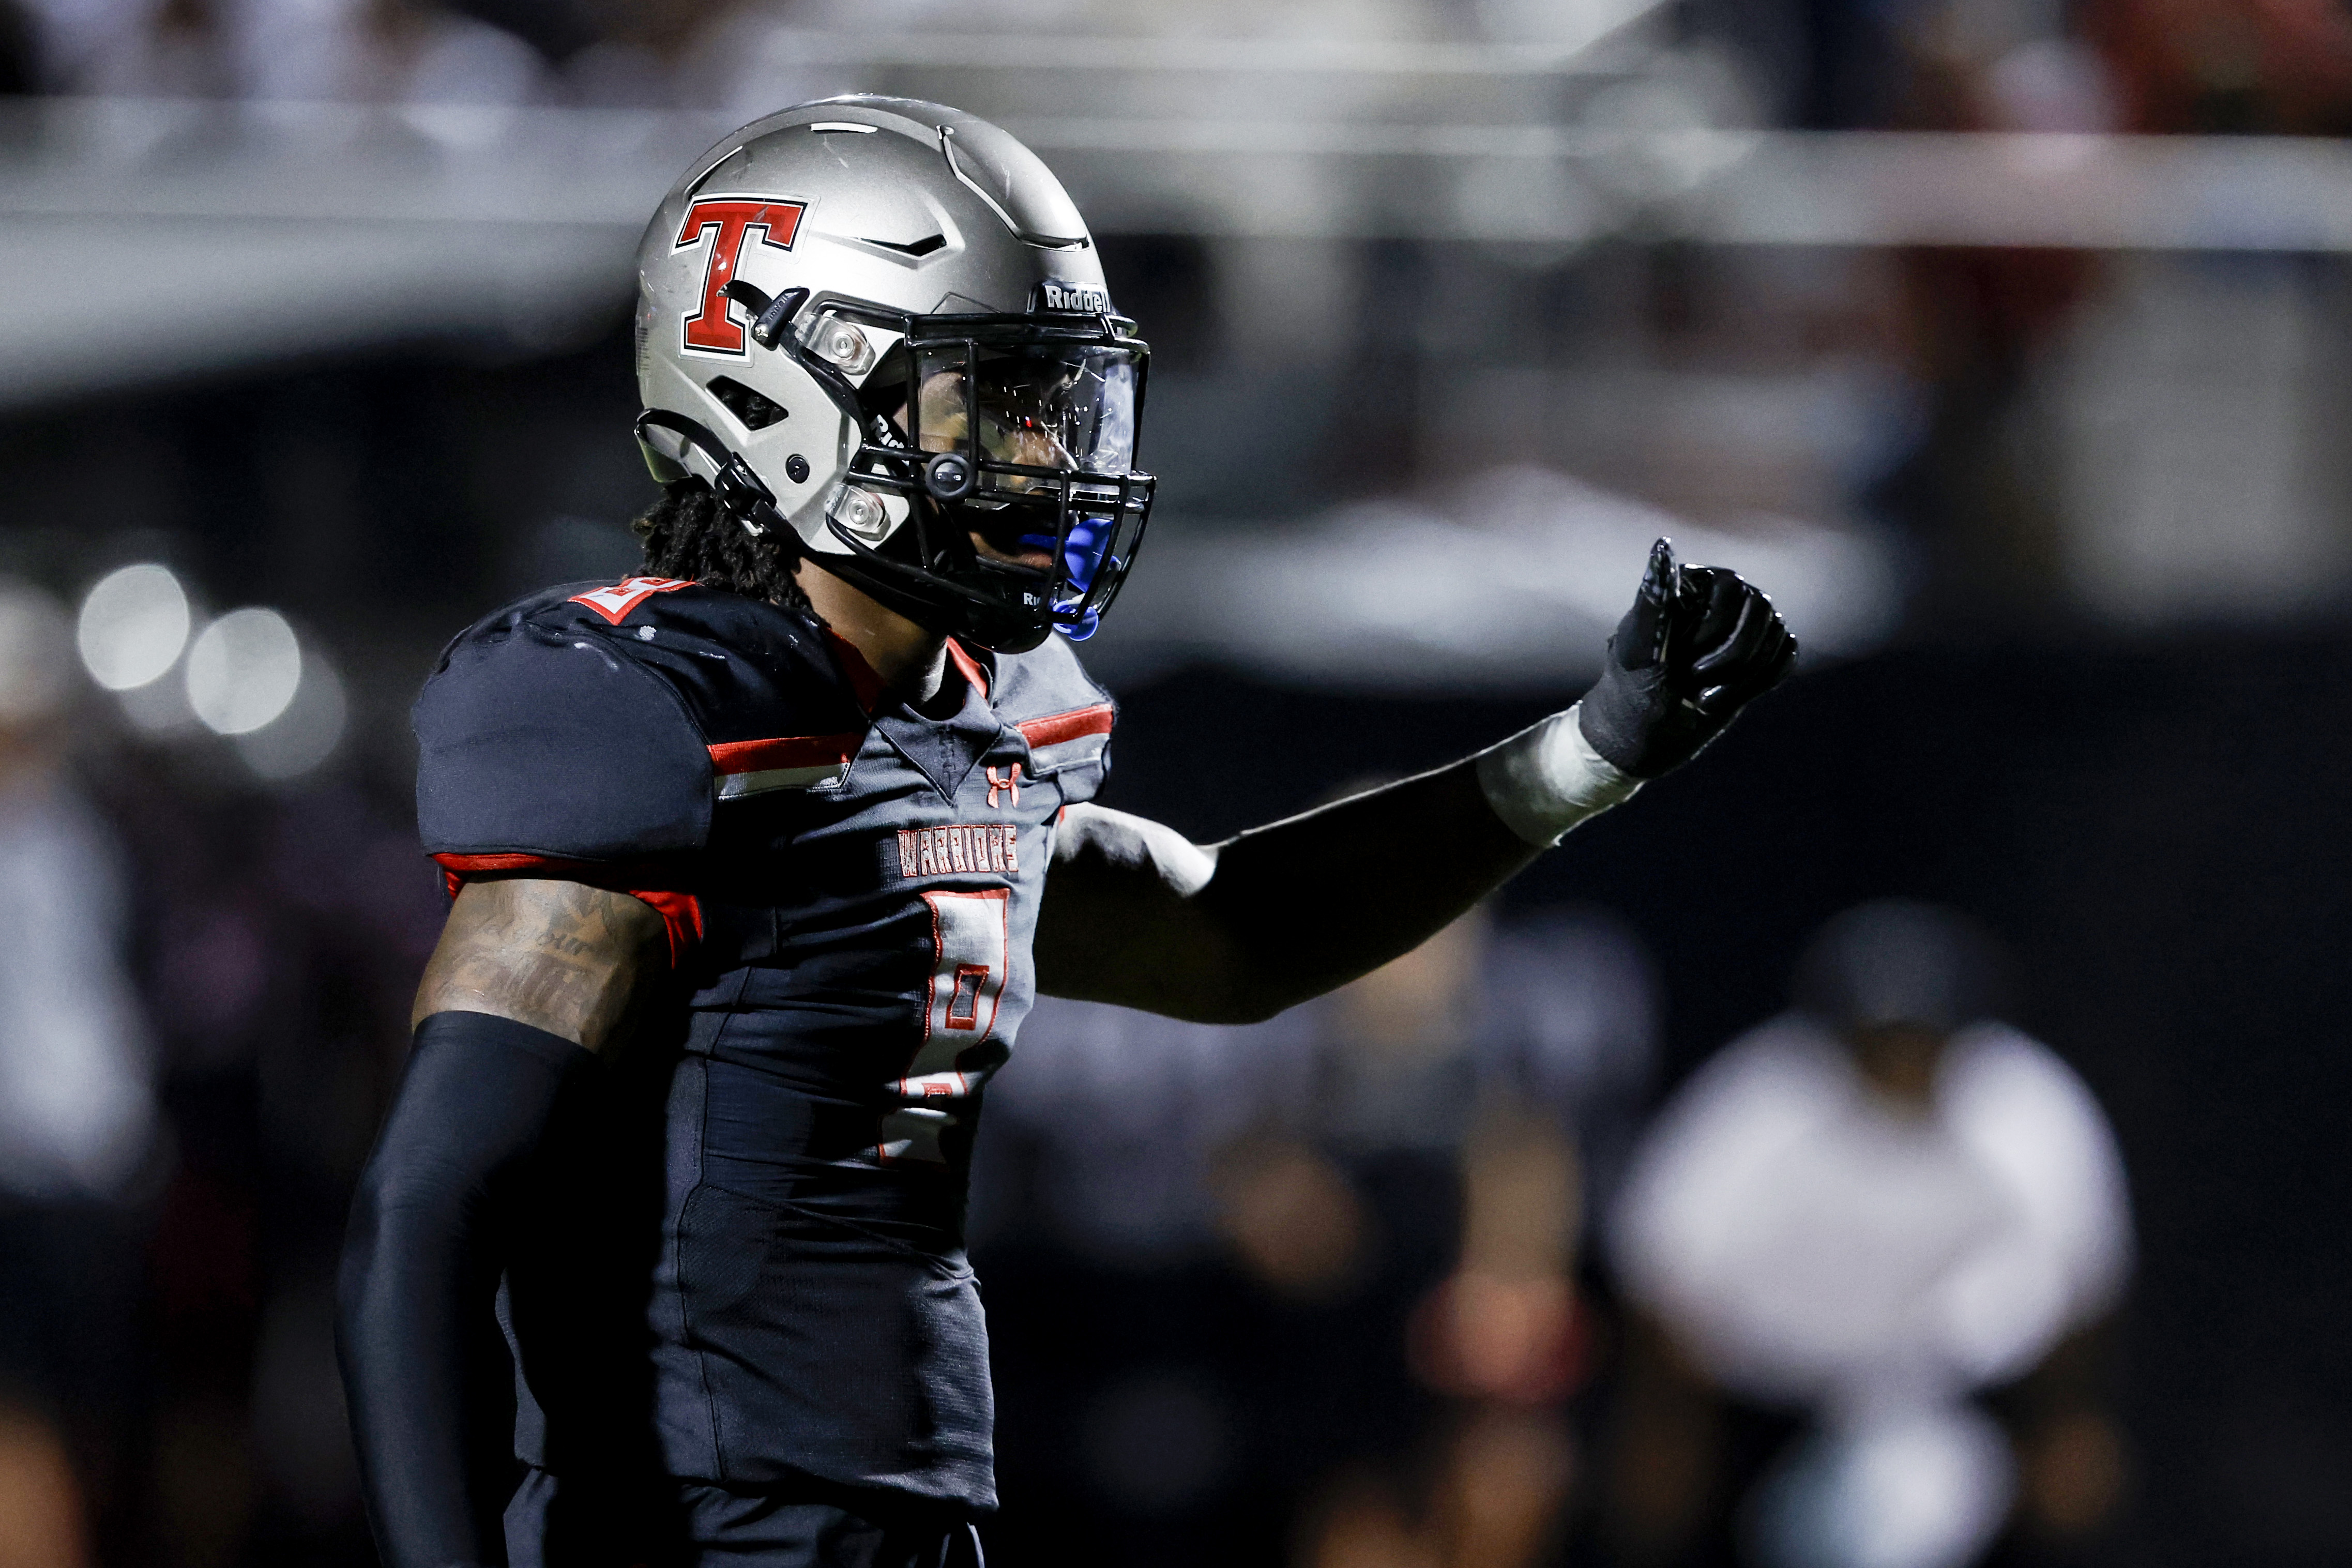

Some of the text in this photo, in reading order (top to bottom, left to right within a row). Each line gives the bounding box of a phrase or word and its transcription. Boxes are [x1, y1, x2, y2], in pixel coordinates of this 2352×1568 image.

[672, 193, 809, 362] T
[1044, 285, 1111, 313] Riddell
[897, 824, 1019, 877] WARRIORS
